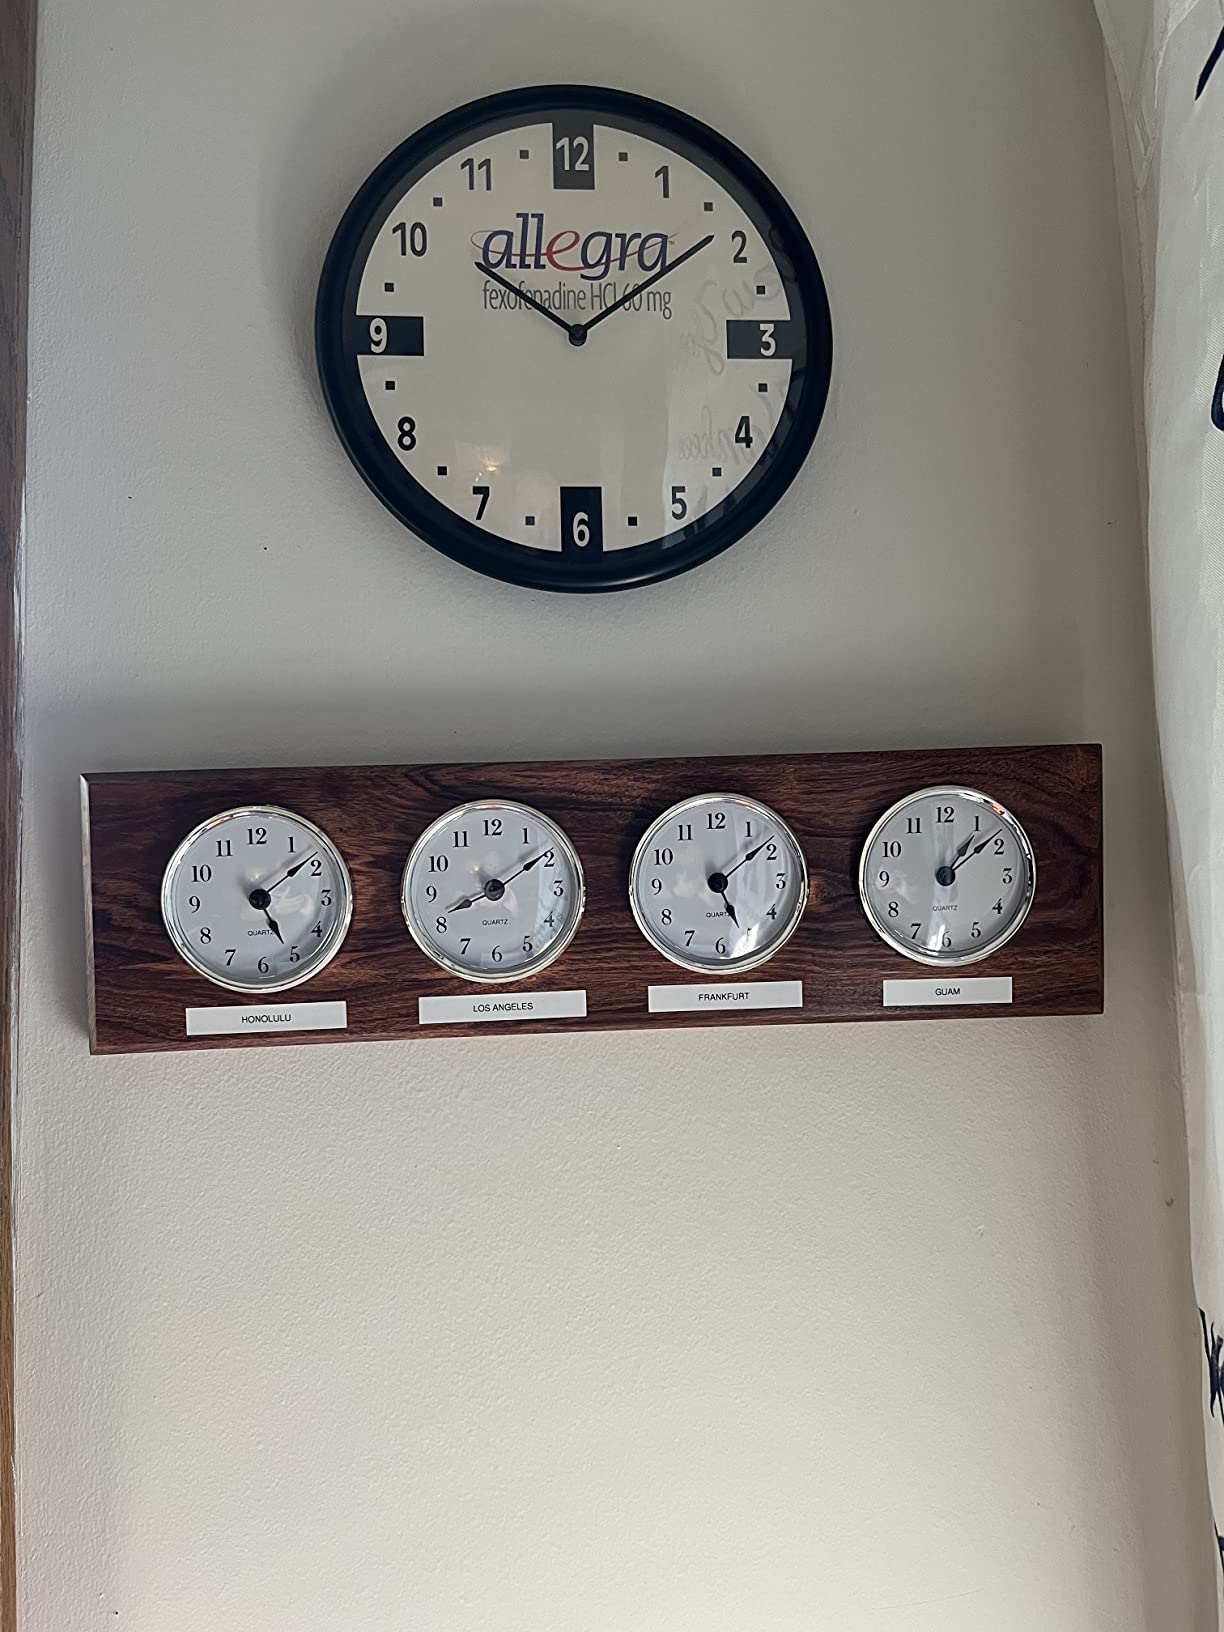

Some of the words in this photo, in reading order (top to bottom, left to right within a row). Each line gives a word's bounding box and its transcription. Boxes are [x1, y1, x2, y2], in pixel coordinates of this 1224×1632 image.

[556, 137, 589, 170] 12
[461, 158, 491, 190] 11
[655, 166, 669, 198] 1
[393, 222, 427, 256] 10
[481, 212, 669, 281] allegra
[732, 231, 747, 263] 2
[623, 283, 642, 312] 60
[647, 290, 672, 320] mg
[370, 318, 387, 353] 9
[760, 324, 775, 356] 3
[398, 417, 416, 451] 8
[735, 416, 752, 448] 4
[473, 486, 489, 520] 7
[672, 486, 687, 520] 5
[573, 512, 589, 546] 6
[707, 813, 725, 829] 12
[936, 807, 954, 823] 12
[484, 819, 502, 835] 12
[745, 822, 752, 837] 1
[906, 818, 922, 833] 11
[974, 816, 980, 831] 1
[248, 828, 267, 844] 12
[453, 831, 469, 847] 11
[522, 828, 529, 844] 1
[678, 825, 693, 840] 11
[216, 840, 232, 857] 11
[288, 837, 295, 852] 1
[766, 844, 777, 860] 2
[883, 841, 901, 857] 10
[994, 839, 1004, 855] 2
[428, 856, 448, 872] 10
[543, 851, 555, 868] 2
[654, 849, 673, 865] 10
[192, 865, 211, 882] 10
[311, 860, 322, 876] 2
[1003, 868, 1012, 883] 3
[652, 879, 662, 894] 9
[776, 874, 786, 889] 3
[879, 871, 889, 887] 9
[427, 886, 437, 902] 9
[553, 881, 563, 897] 3
[189, 897, 200, 913] 9
[321, 890, 331, 906] 3
[992, 898, 1002, 914] 4
[662, 909, 672, 925] 8
[766, 904, 777, 919] 4
[888, 902, 898, 917] 8
[436, 917, 447, 932] 8
[481, 918, 508, 926] QUARTZ
[544, 912, 554, 927] 4
[200, 928, 211, 944] 8
[311, 921, 322, 937] 4
[911, 924, 921, 939] 7
[971, 922, 981, 938] 5
[523, 936, 532, 951] 5
[685, 930, 695, 946] 7
[716, 938, 725, 954] 6
[941, 931, 951, 947] 6
[290, 946, 300, 963] 5
[460, 939, 470, 954] 7
[492, 946, 502, 962] 6
[225, 950, 236, 966] 7
[258, 957, 268, 973] 6
[698, 992, 750, 1001] FRANKFURT
[935, 987, 961, 996] GUAM
[473, 1004, 491, 1012] LOS
[492, 1002, 534, 1012] ANGELES
[241, 1014, 291, 1023] HONOLULU
